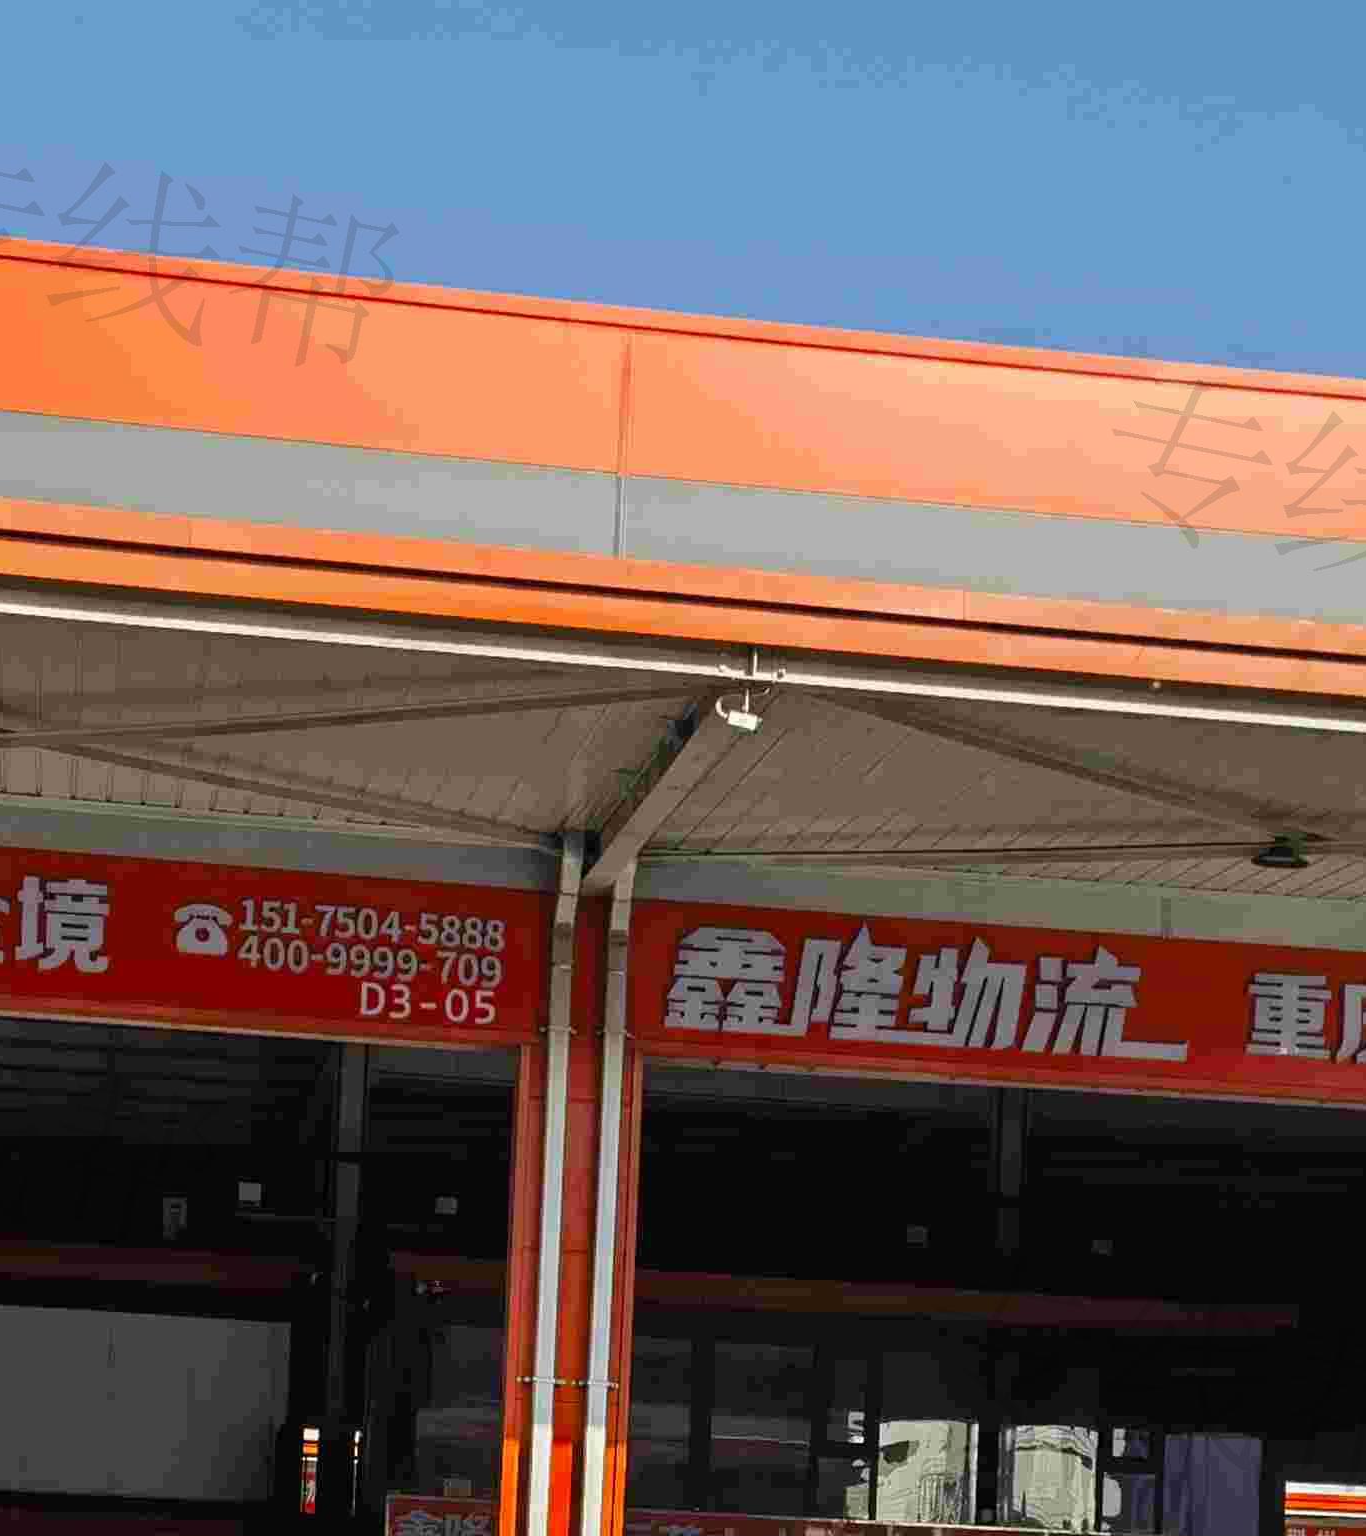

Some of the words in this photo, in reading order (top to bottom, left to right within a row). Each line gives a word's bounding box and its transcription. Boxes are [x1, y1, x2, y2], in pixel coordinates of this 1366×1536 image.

[239, 898, 506, 953] 151-7504-5888
[237, 940, 504, 989] 400-9999-709
[359, 982, 497, 1024] D3-05
[663, 922, 1187, 1062] 鑫隆物流
